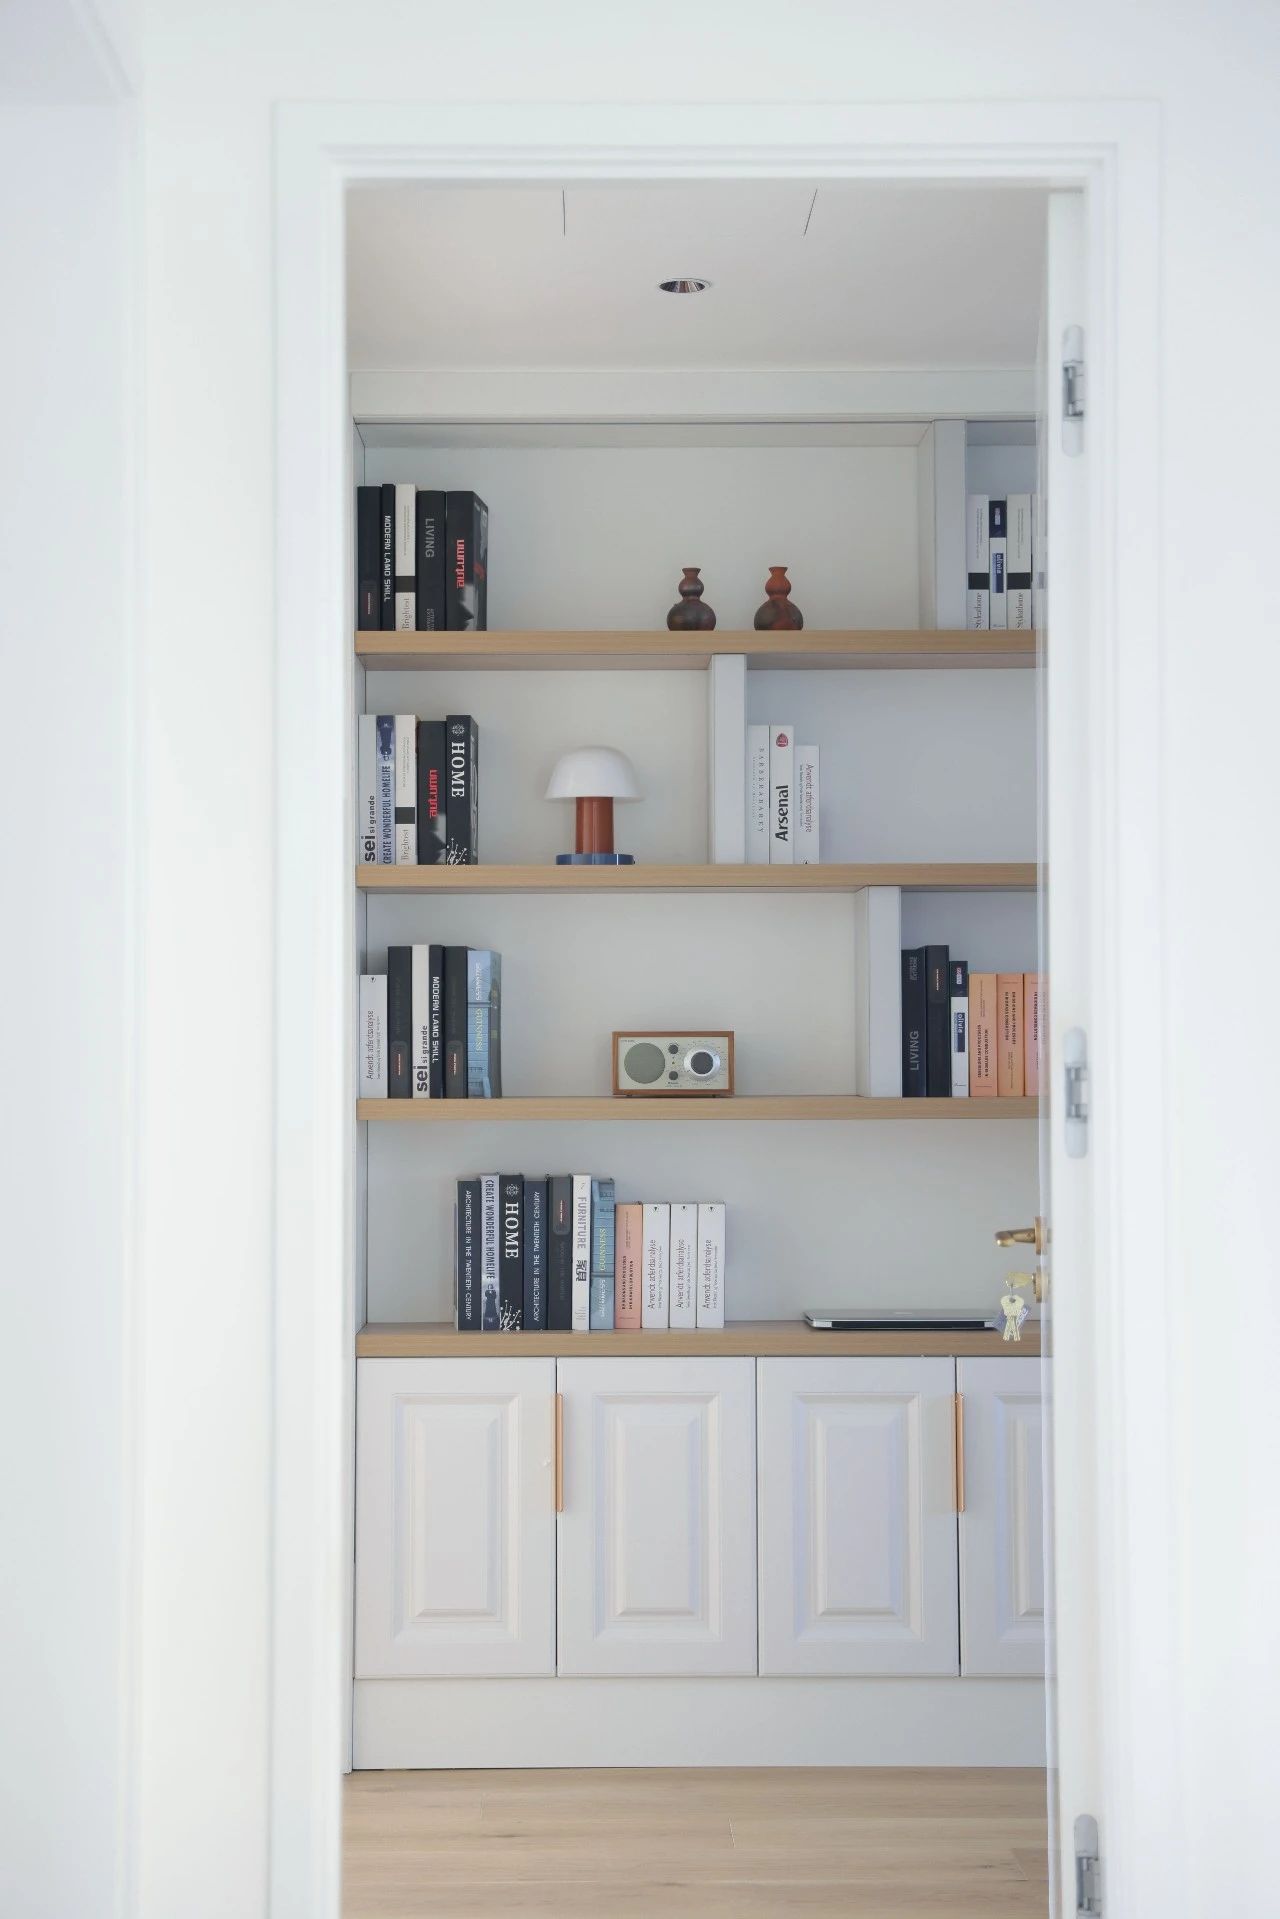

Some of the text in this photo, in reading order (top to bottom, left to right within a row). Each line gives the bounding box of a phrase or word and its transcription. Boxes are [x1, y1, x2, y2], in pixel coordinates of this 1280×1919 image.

[384, 515, 392, 550] MODERN
[425, 518, 434, 558] LIVING
[456, 540, 465, 588] autumn
[430, 769, 438, 818] autumn
[452, 742, 465, 798] HOME
[382, 765, 391, 864] CREATE WONDERFUL HOMELIFE
[775, 785, 788, 841] Arsenal
[361, 835, 376, 862] sei
[910, 1031, 919, 1071] LIVING
[414, 1066, 428, 1092] sei
[485, 1179, 495, 1280] CREATE WONDERFUL HOMELIFE
[505, 1202, 519, 1258] HOME
[577, 1197, 586, 1249] FURNITURE
